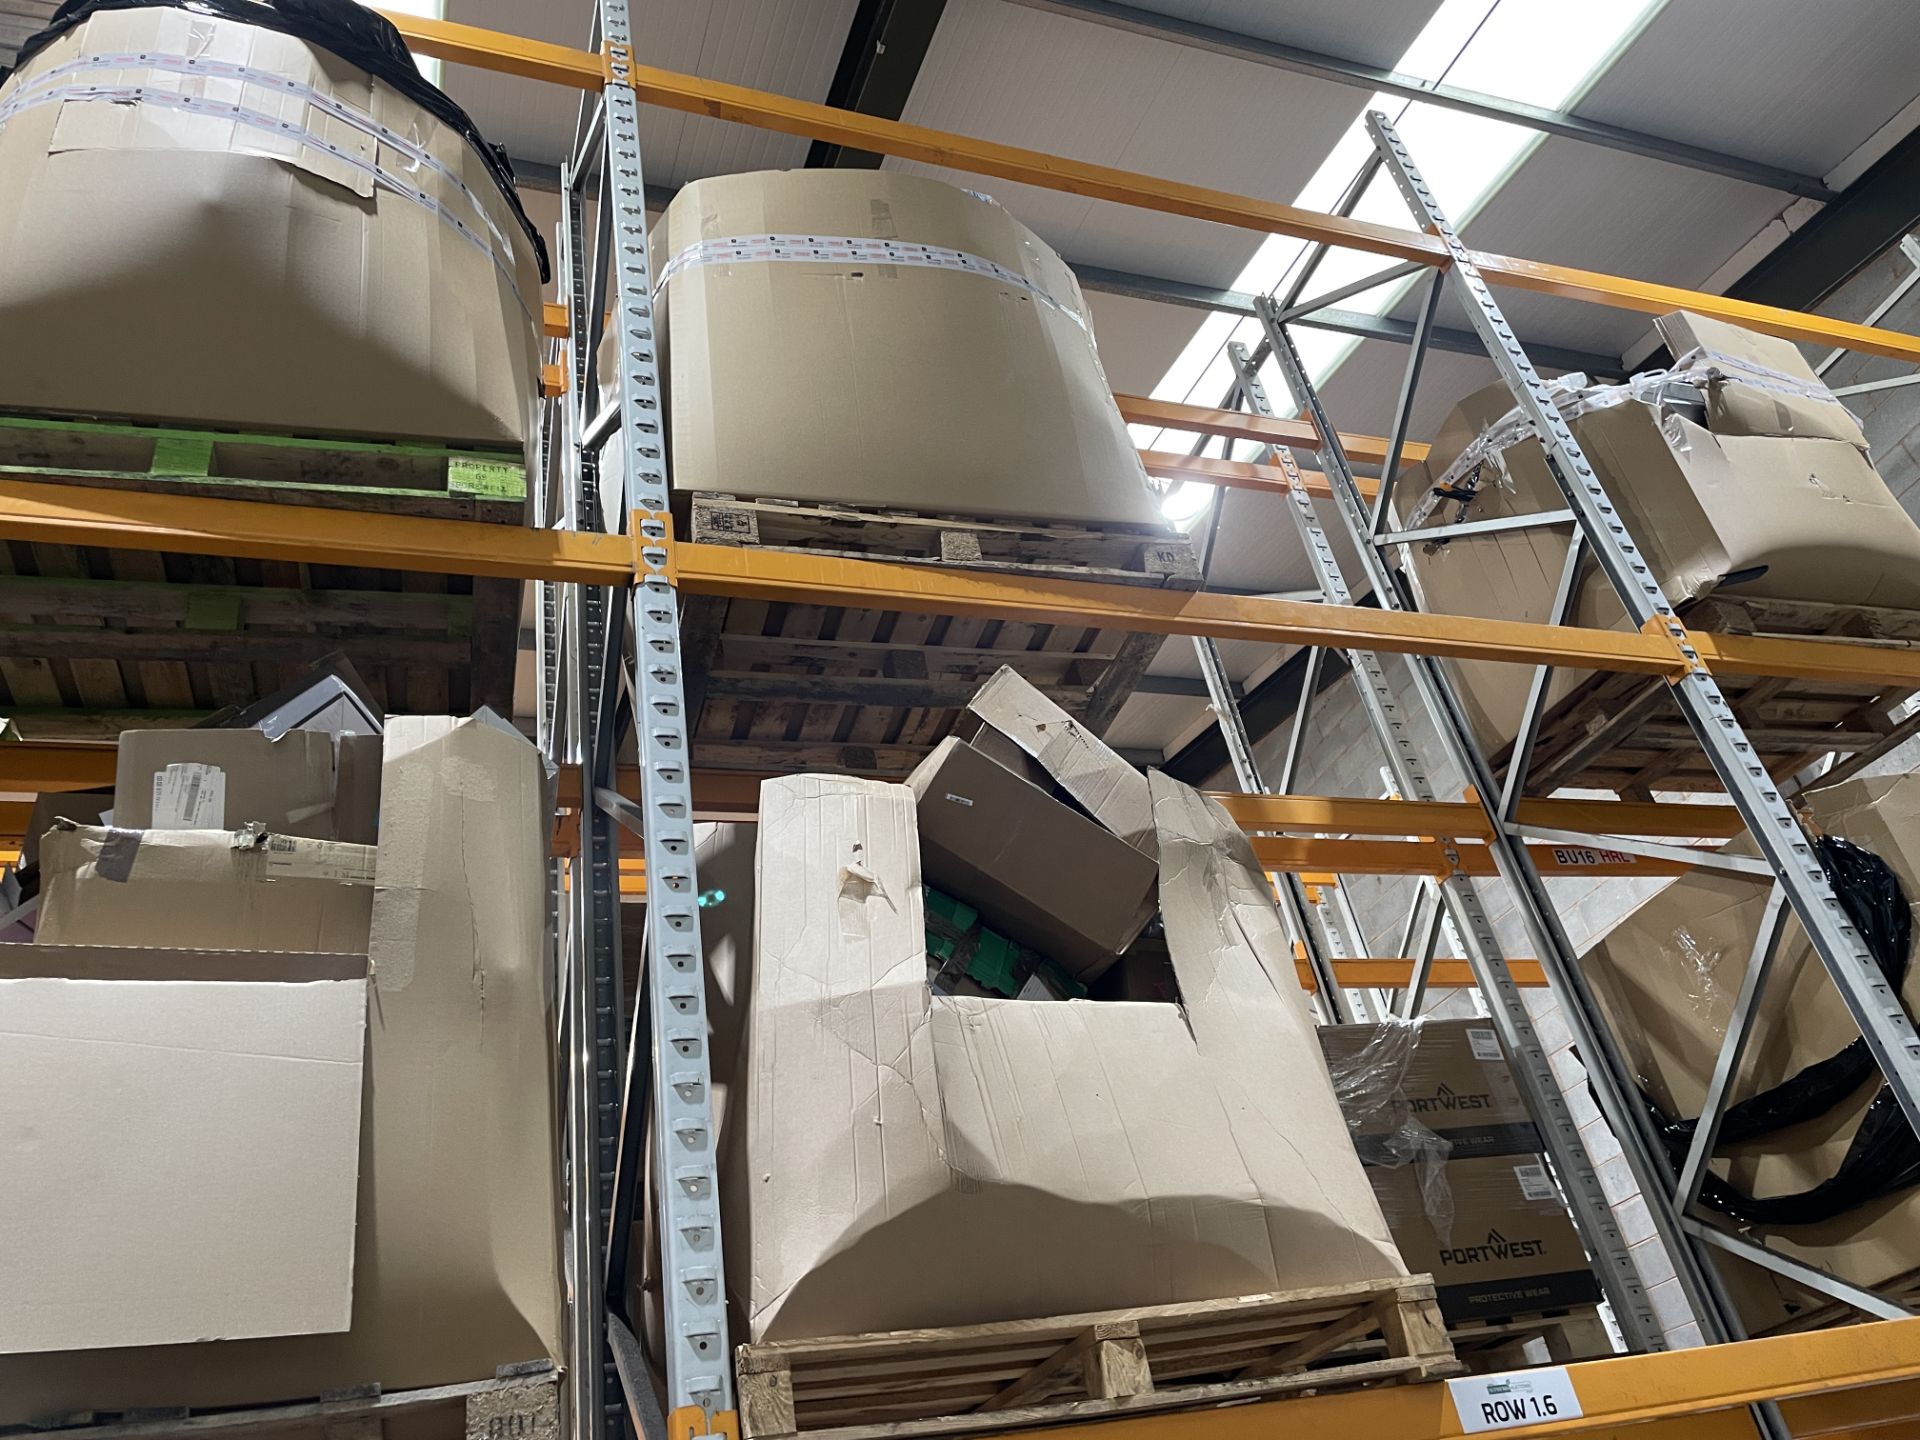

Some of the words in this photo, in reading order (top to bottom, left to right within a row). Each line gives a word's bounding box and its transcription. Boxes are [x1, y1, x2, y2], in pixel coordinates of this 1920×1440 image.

[1554, 849, 1596, 864] BU16
[1599, 851, 1631, 863] HRL
[1481, 1398, 1527, 1425] ROW
[1529, 1394, 1558, 1418] 1.6
